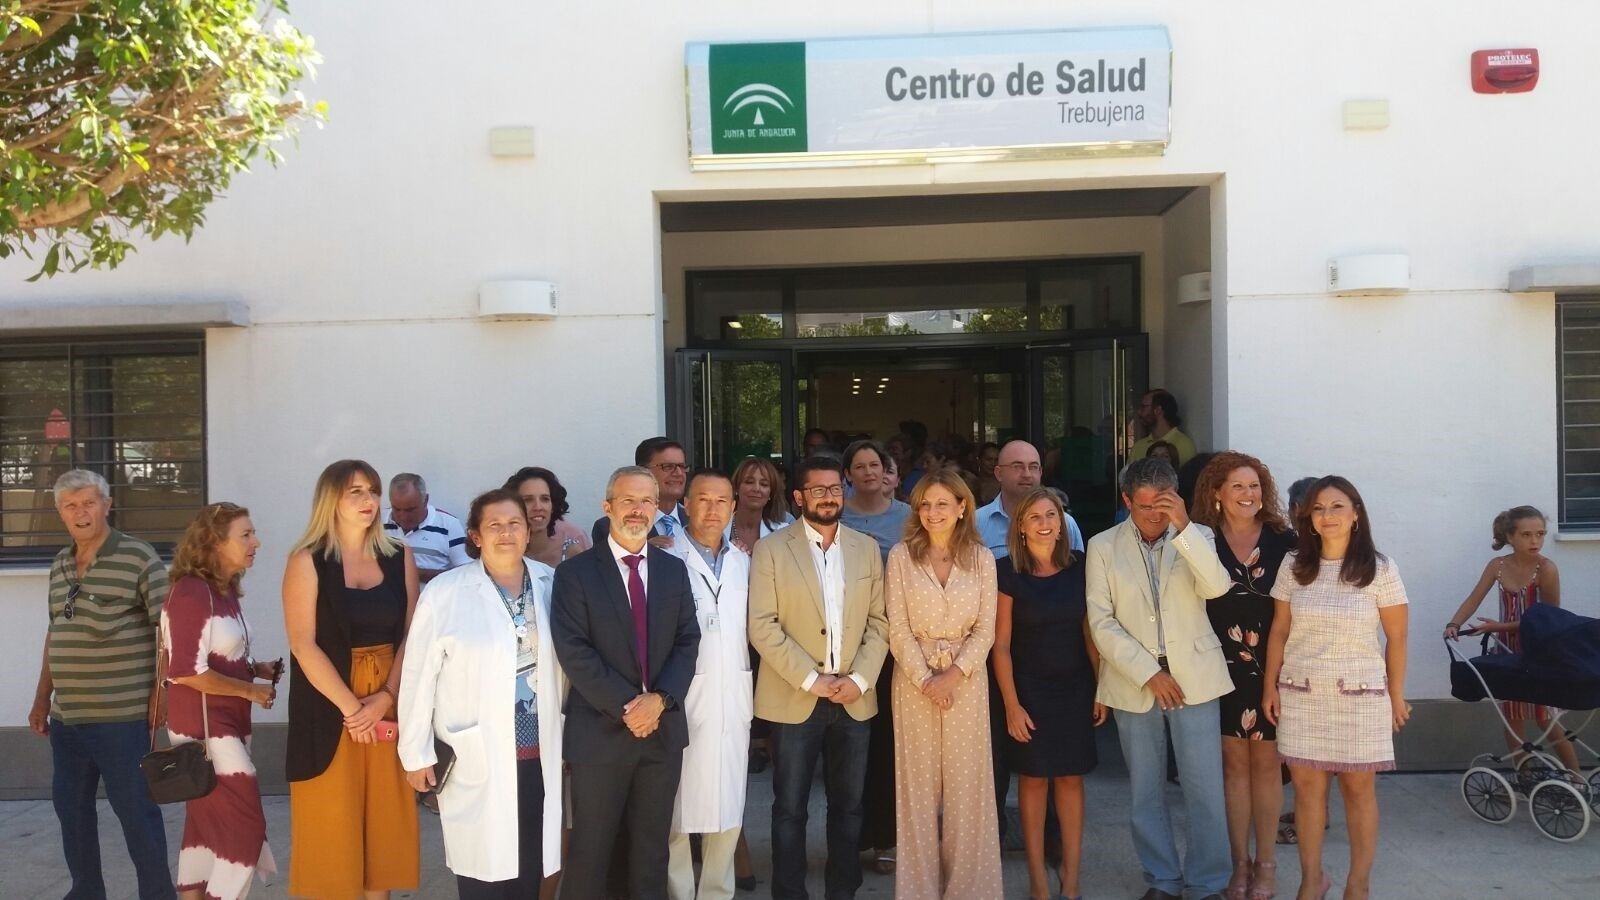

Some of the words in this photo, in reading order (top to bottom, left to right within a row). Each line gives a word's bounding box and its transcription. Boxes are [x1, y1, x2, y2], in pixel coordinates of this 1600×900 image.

[885, 67, 995, 101] Centro
[1006, 62, 1044, 97] de
[1056, 58, 1146, 95] Salud
[1057, 101, 1145, 127] Trebujena
[723, 129, 745, 138] JUNTA
[747, 129, 756, 138] DE
